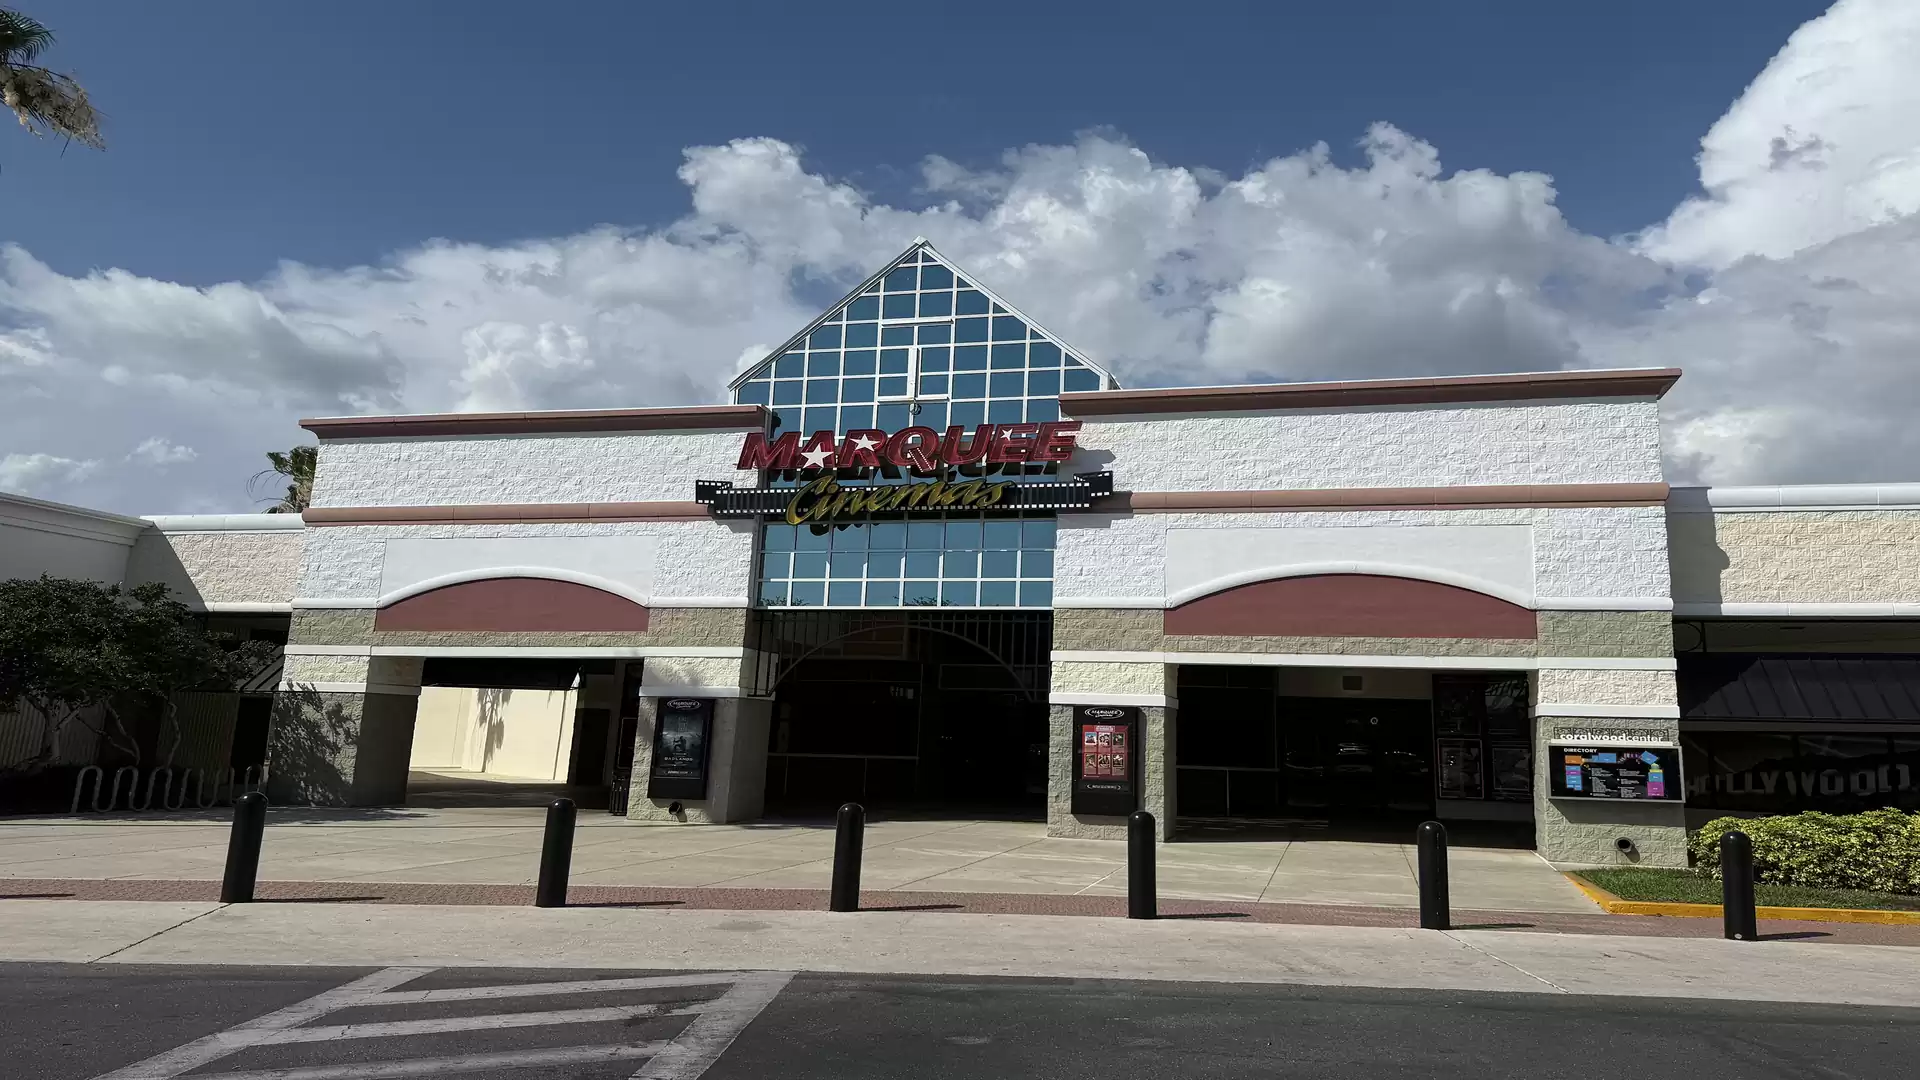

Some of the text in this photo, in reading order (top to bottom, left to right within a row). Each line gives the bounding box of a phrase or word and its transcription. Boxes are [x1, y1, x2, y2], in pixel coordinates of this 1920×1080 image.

[734, 420, 1083, 471] MARQUEE
[785, 474, 1015, 526] Cinemas
[1685, 763, 1911, 800] HOLLYWOOD
